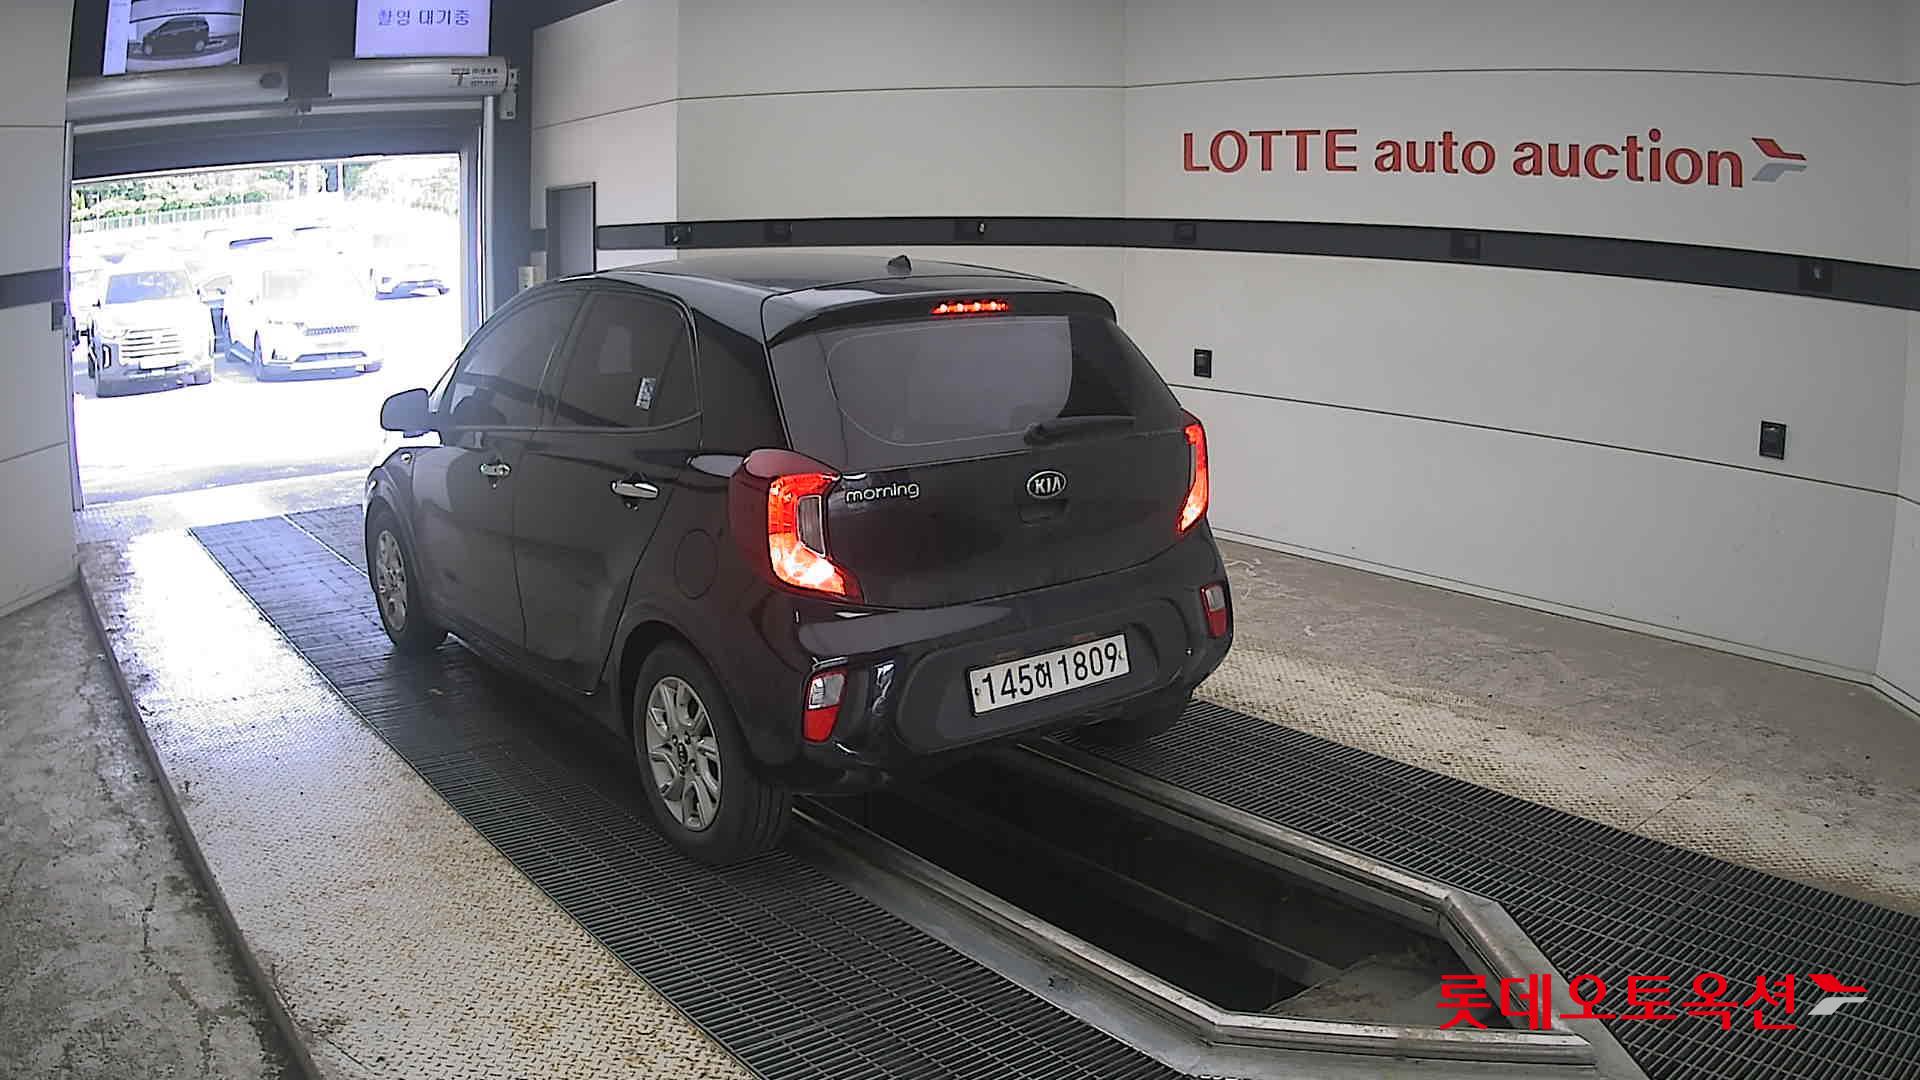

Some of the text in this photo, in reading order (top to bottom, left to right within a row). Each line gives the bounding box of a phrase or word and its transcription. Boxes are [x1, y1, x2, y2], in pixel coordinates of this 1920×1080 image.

[419, 9, 470, 26] 대기중
[1183, 128, 1743, 188] LOTTE auto auction
[846, 483, 920, 502] morning
[1034, 476, 1061, 494] KIA
[982, 642, 1118, 704] 145허 1809
